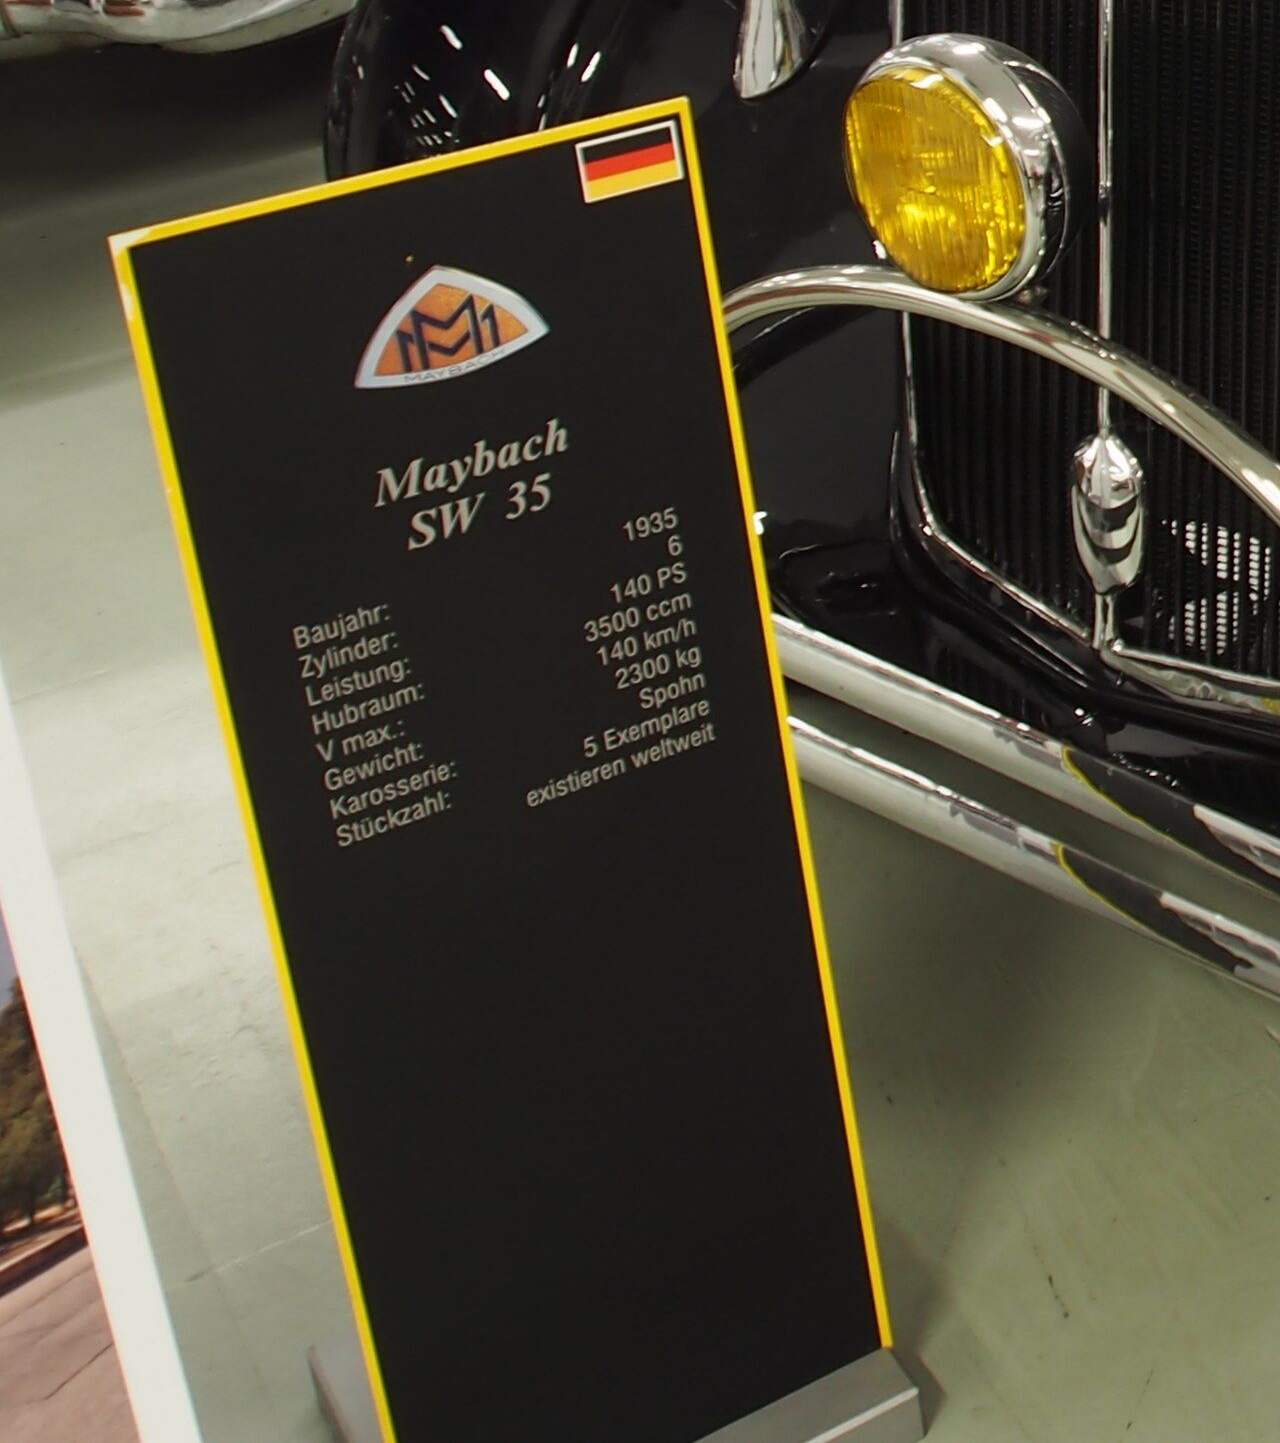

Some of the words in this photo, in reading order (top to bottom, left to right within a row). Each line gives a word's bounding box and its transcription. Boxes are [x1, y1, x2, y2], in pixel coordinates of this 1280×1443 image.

[374, 417, 569, 508] Maybach
[408, 492, 486, 551] SW
[505, 473, 552, 520] 35
[293, 604, 390, 650] Baujahr:
[623, 508, 678, 541] 1935
[299, 632, 398, 678] Zylinder:
[668, 534, 683, 556] 6
[305, 658, 411, 707] Leistung:
[610, 574, 651, 603] 140
[656, 562, 687, 589] PS
[312, 683, 425, 735] Hubraum:
[584, 607, 640, 642] 3500
[646, 592, 692, 621] ccm
[316, 739, 334, 762] V
[341, 720, 405, 756] max.:
[597, 636, 638, 666] 140
[643, 618, 697, 651] km/h
[324, 743, 424, 791] Gewicht:
[615, 654, 670, 690] 2300
[675, 646, 702, 668] kg
[330, 762, 457, 820] Karosserie:
[639, 673, 706, 709] Spohn
[336, 791, 452, 847] Stückzahl:
[583, 737, 598, 757] 5
[603, 699, 710, 751] Exemplare
[526, 758, 626, 807] existieren
[630, 722, 716, 768] weltweit
